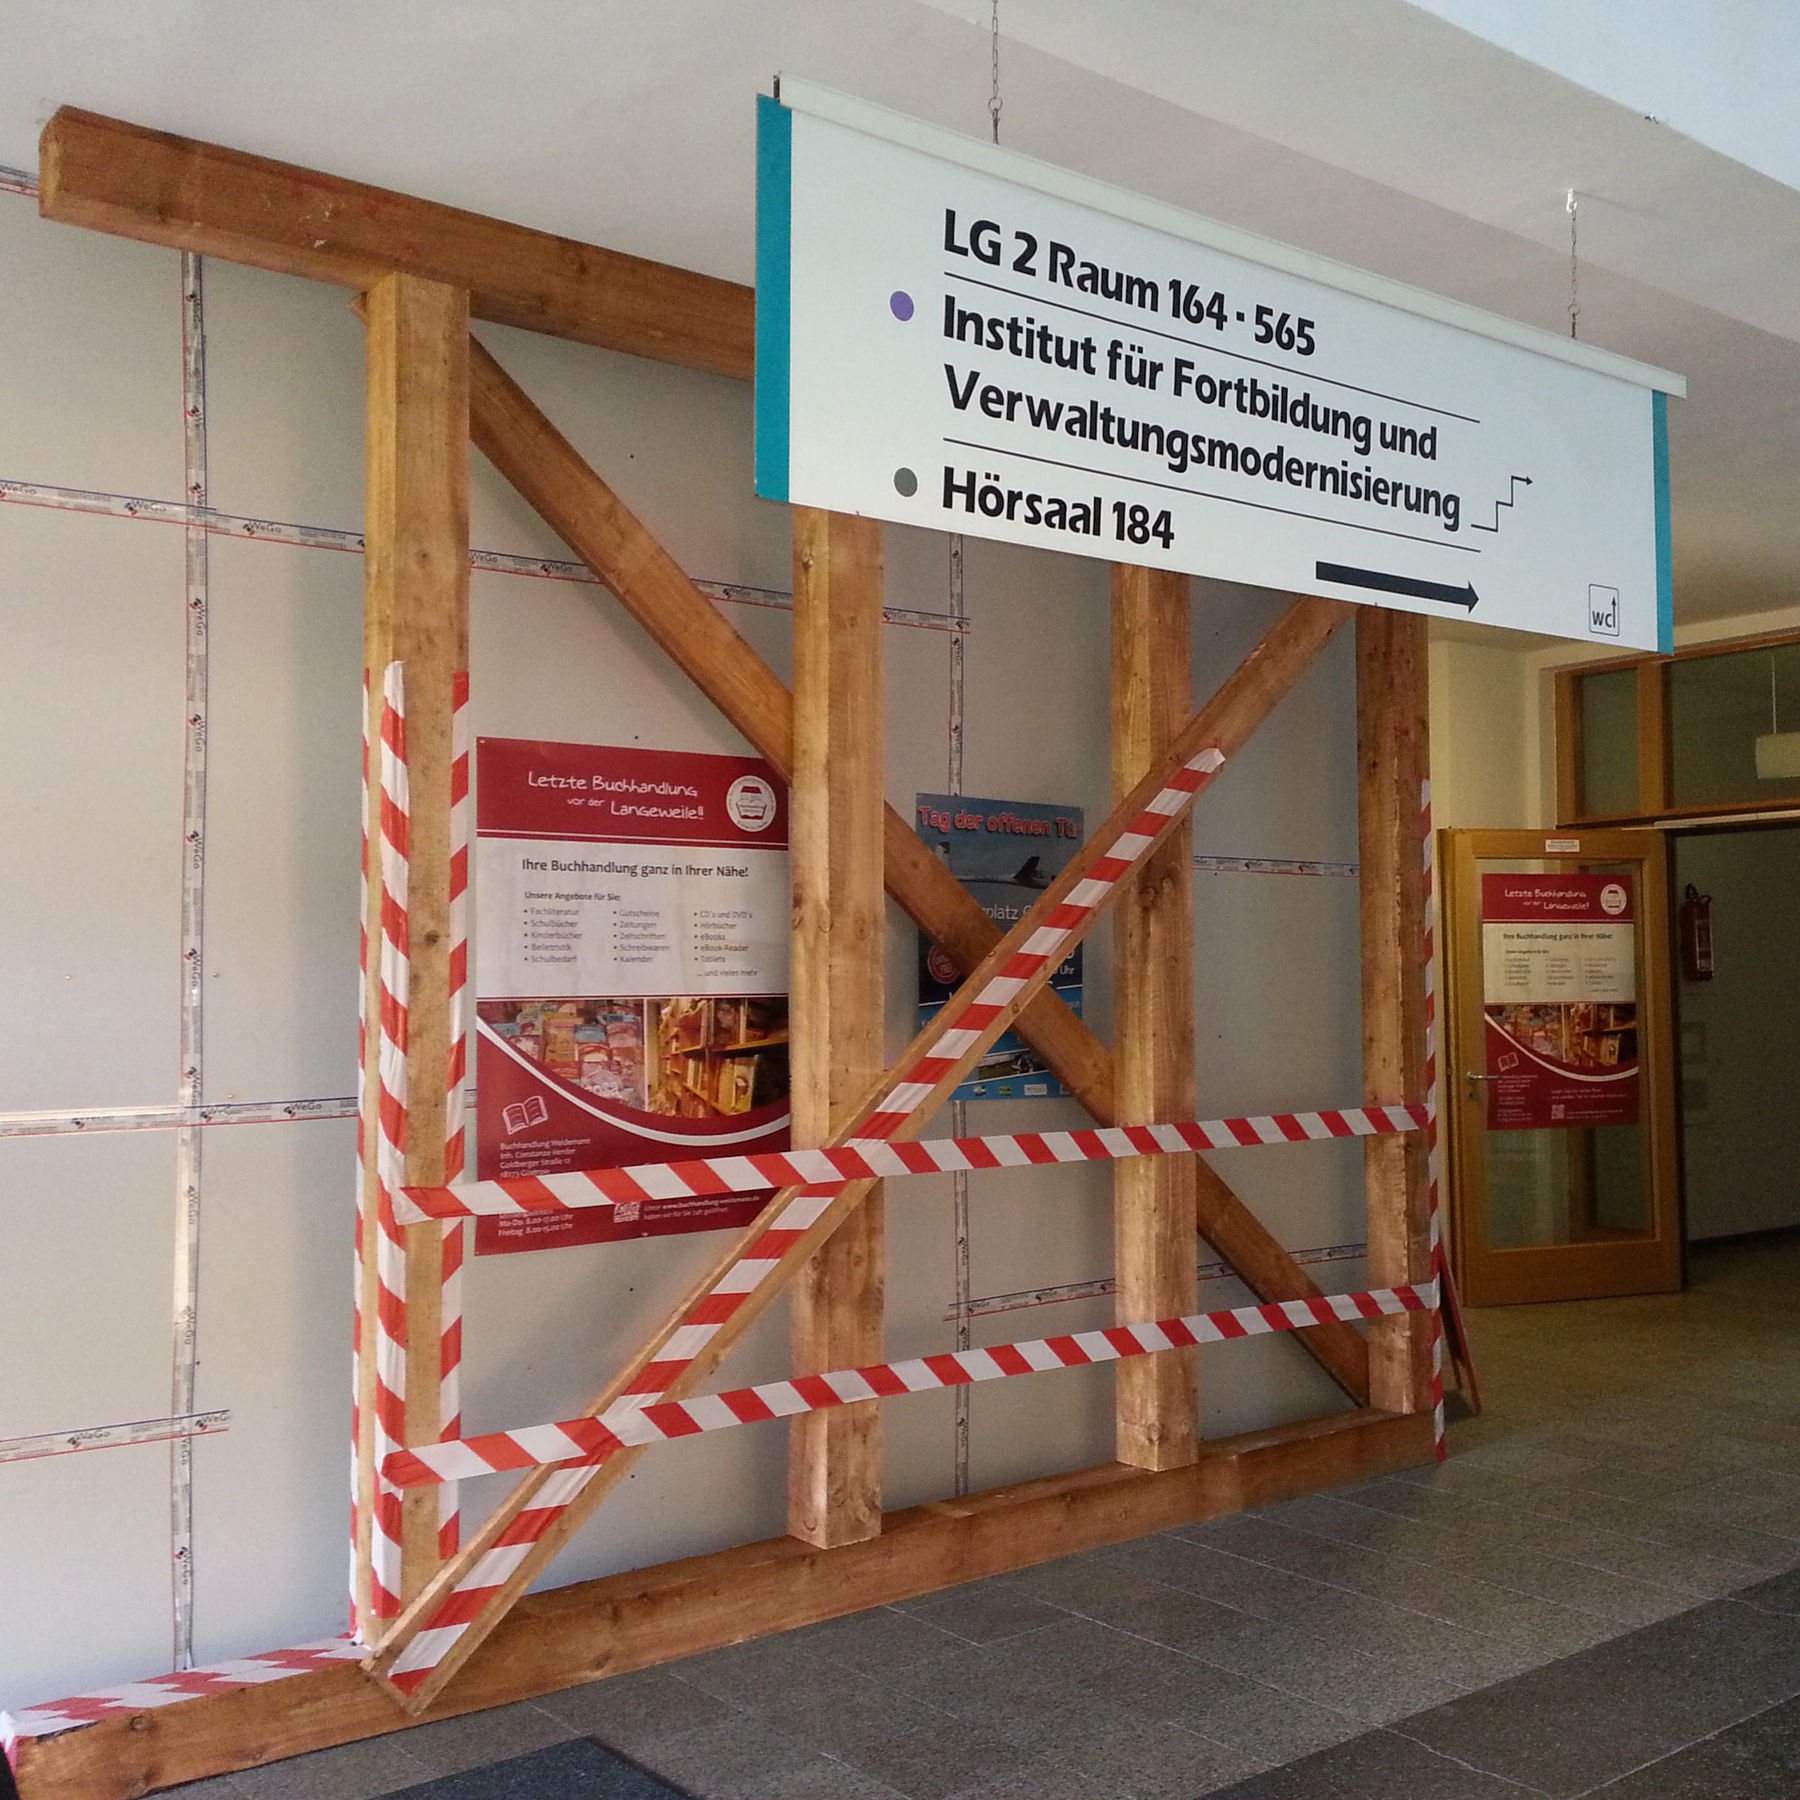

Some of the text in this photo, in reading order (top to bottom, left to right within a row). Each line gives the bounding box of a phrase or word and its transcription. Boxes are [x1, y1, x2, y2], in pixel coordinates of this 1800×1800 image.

[944, 208, 1001, 267] LG
[1012, 231, 1039, 277] 2
[1048, 240, 1159, 312] Raum
[1168, 278, 1228, 332] 164
[1254, 304, 1316, 356] 565
[943, 295, 1438, 461] Institut für Fortbildung und
[943, 363, 1461, 532] Verwaltungsmodernisierung
[943, 466, 1176, 550] Hörsaal 184
[528, 771, 699, 797] Letzte Buchhandlung
[566, 798, 585, 806] vor
[587, 798, 605, 807] der
[918, 806, 950, 833] Tag
[954, 809, 983, 830] der
[986, 812, 1050, 835] offenen
[522, 859, 750, 877] Ihre Buchhandlung ganz in Ihrer Nähe!
